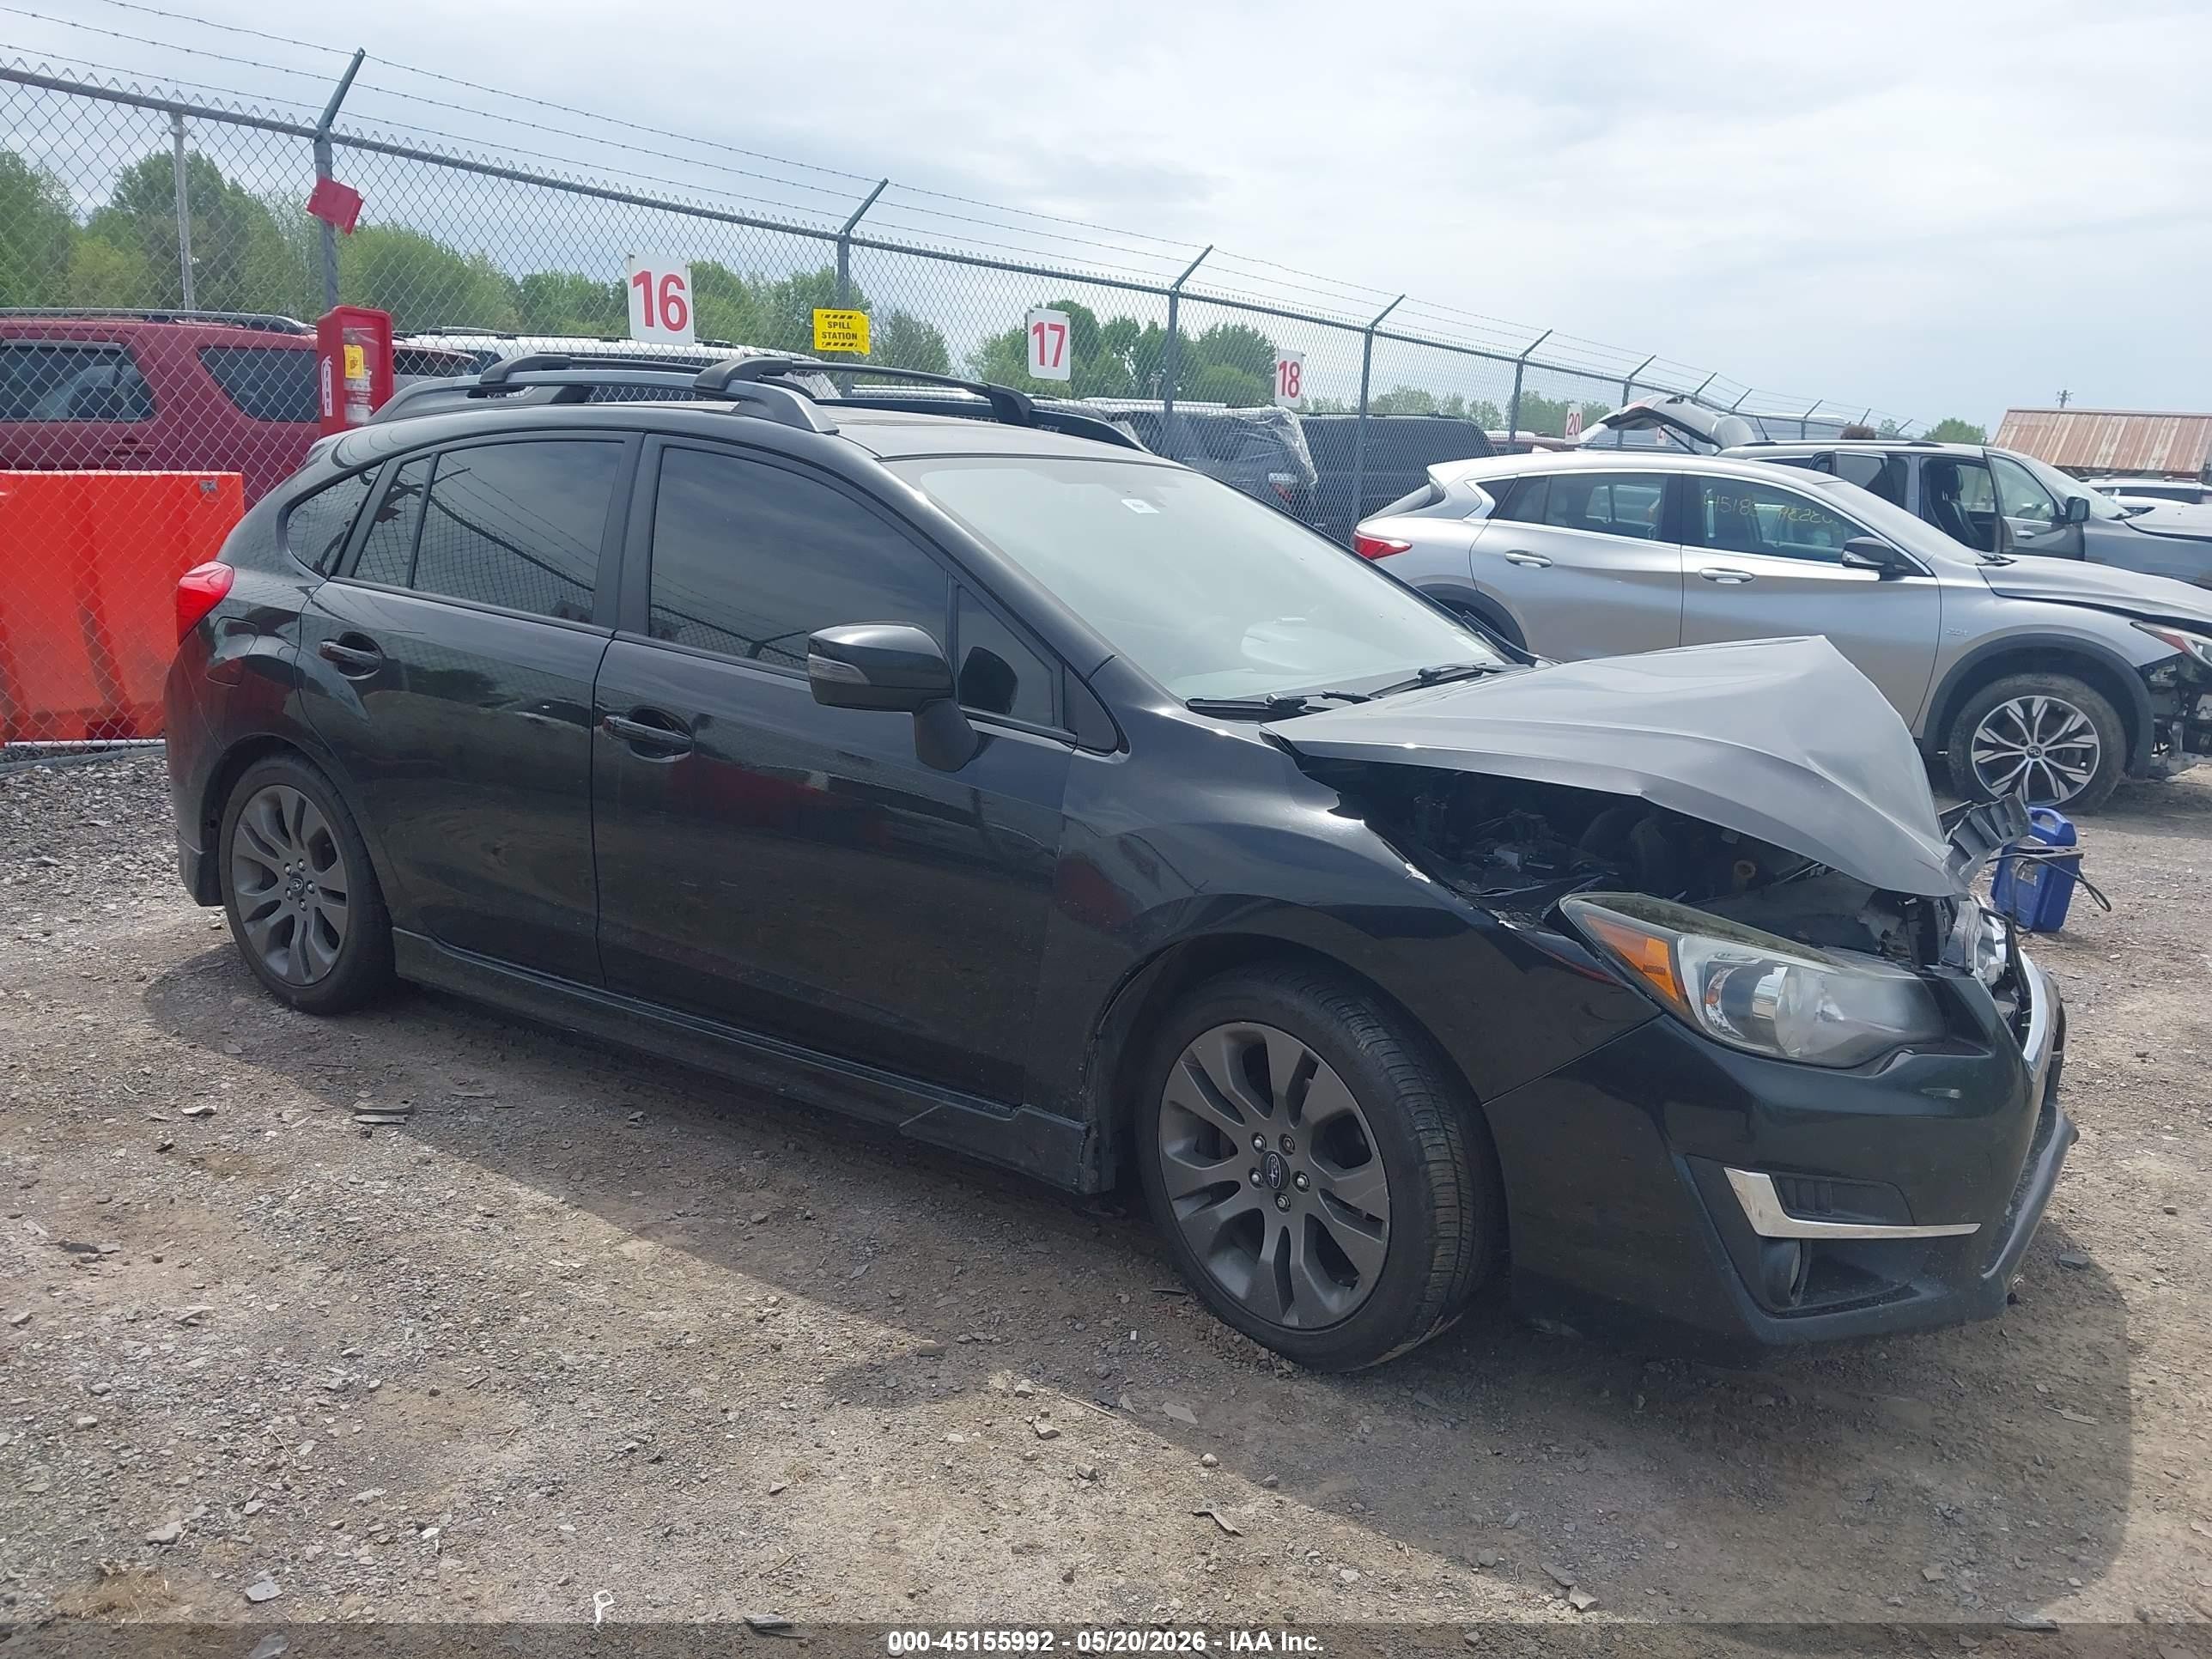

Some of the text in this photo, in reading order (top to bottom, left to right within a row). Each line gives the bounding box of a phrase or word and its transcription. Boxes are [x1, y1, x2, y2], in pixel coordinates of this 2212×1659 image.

[633, 270, 688, 331] 16
[821, 331, 858, 340] STATION
[827, 321, 851, 330] SPILL
[1032, 321, 1066, 368] 17
[1279, 361, 1300, 398] 18
[1567, 412, 1580, 436] 20
